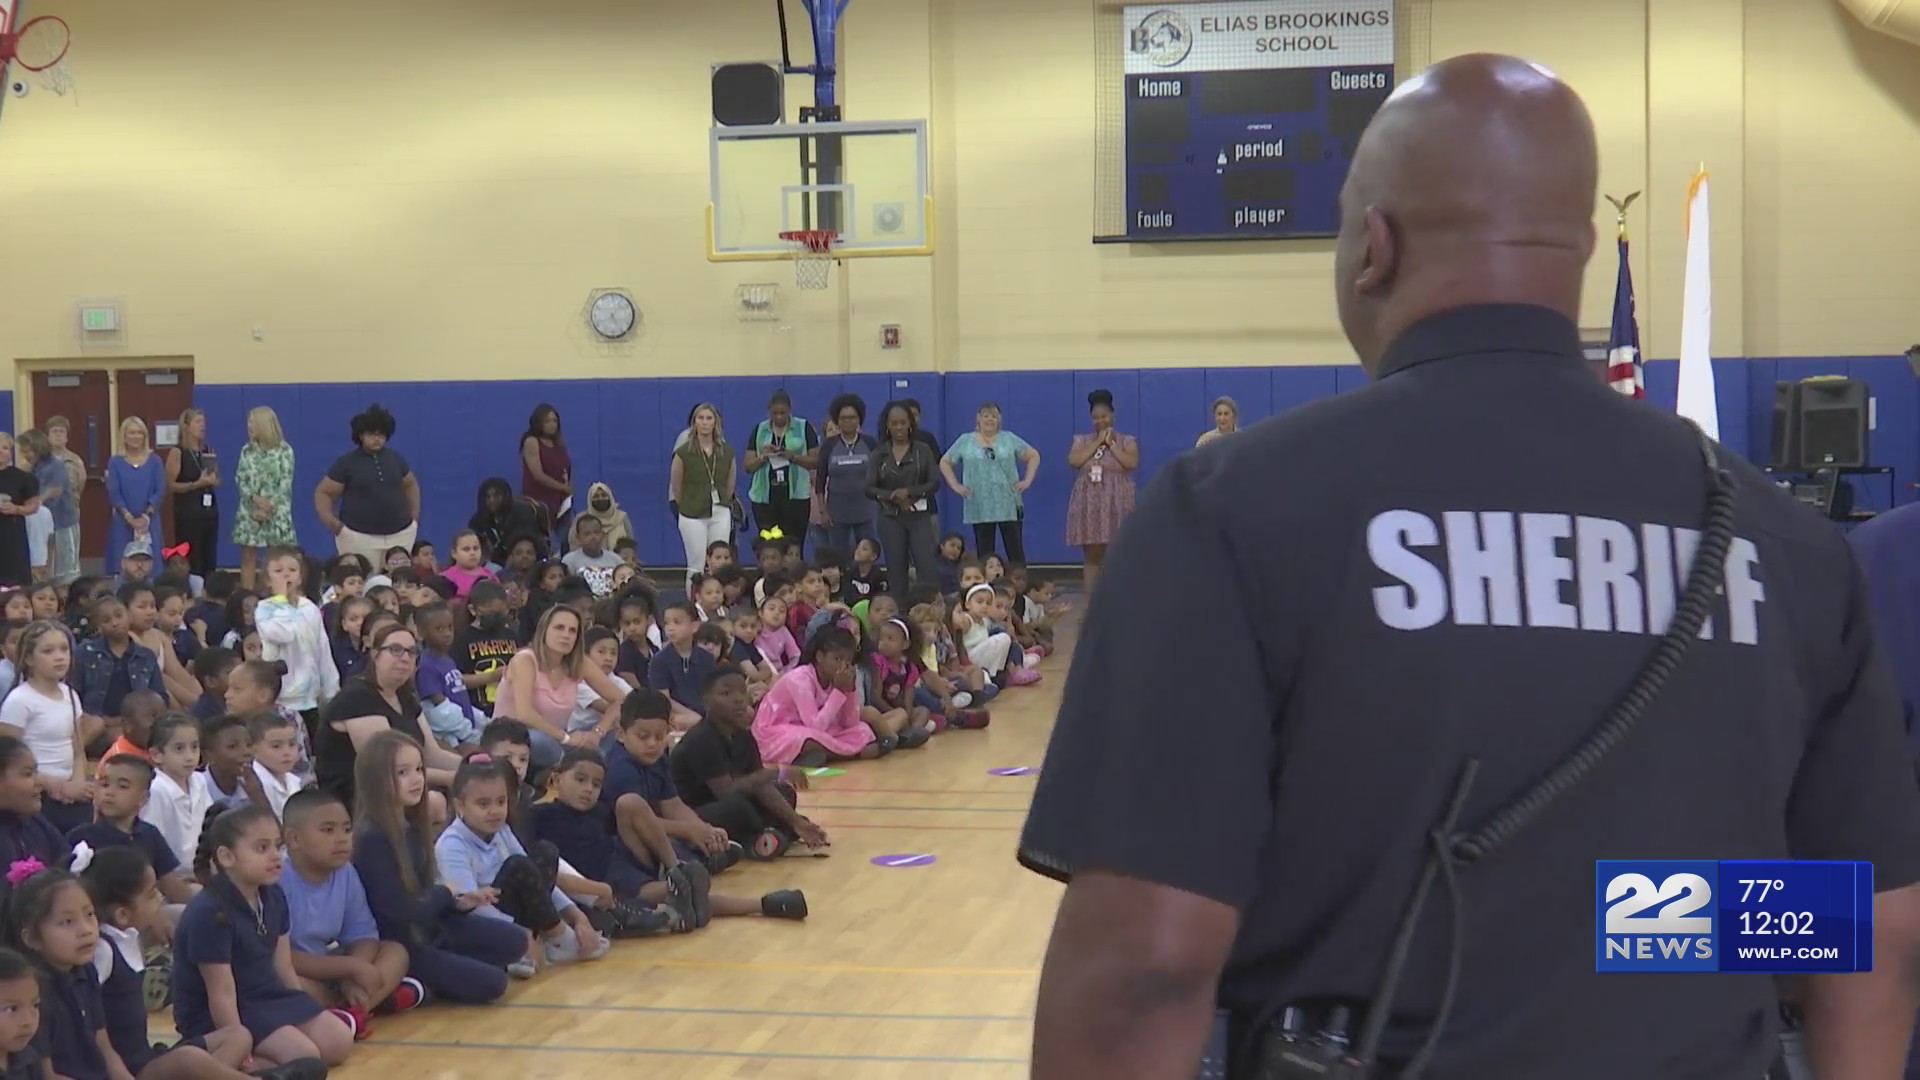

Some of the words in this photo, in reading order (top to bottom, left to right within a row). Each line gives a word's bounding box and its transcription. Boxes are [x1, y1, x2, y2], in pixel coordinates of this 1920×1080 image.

[1200, 15, 1258, 33] ELIAS
[1264, 10, 1390, 30] BROOKINGS
[1255, 35, 1339, 53] SCHOOL
[1138, 78, 1181, 97] Home
[1330, 71, 1386, 90] Guests
[1235, 138, 1283, 161] period
[1137, 209, 1173, 228] fouls
[1234, 206, 1285, 227] player
